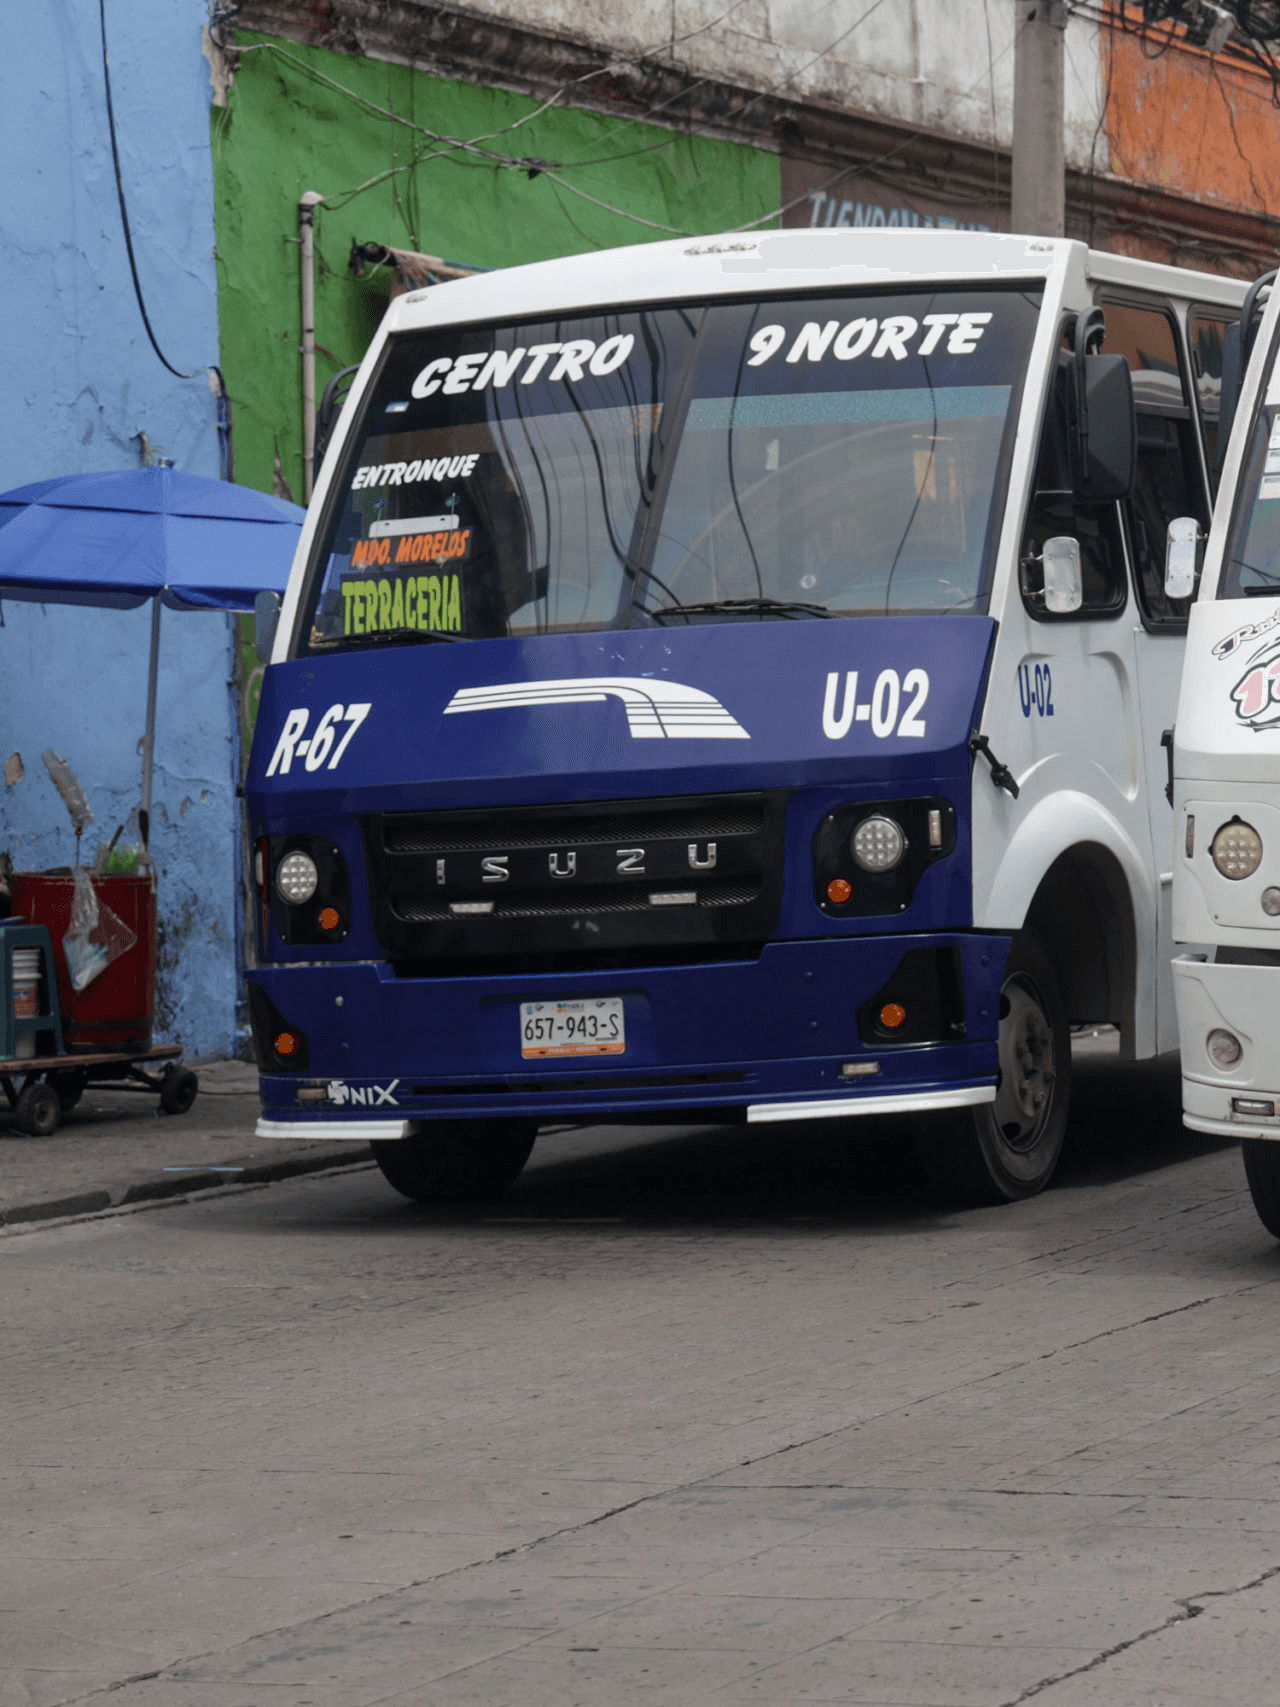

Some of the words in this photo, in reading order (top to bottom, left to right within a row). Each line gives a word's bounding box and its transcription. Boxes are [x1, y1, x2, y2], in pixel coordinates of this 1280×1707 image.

[411, 334, 635, 399] CENTRO
[747, 324, 786, 367] 9
[786, 312, 994, 364] NORTE
[351, 453, 480, 490] ENTRONQUE
[351, 538, 391, 567] MDO.
[395, 529, 471, 564] MORELOS
[341, 574, 462, 636] TERRACERIA
[822, 668, 930, 740] U-02
[1018, 663, 1054, 718] U-02
[266, 703, 372, 777] R-67
[436, 842, 717, 884] ISUZU
[524, 1013, 619, 1041] 657-943-S
